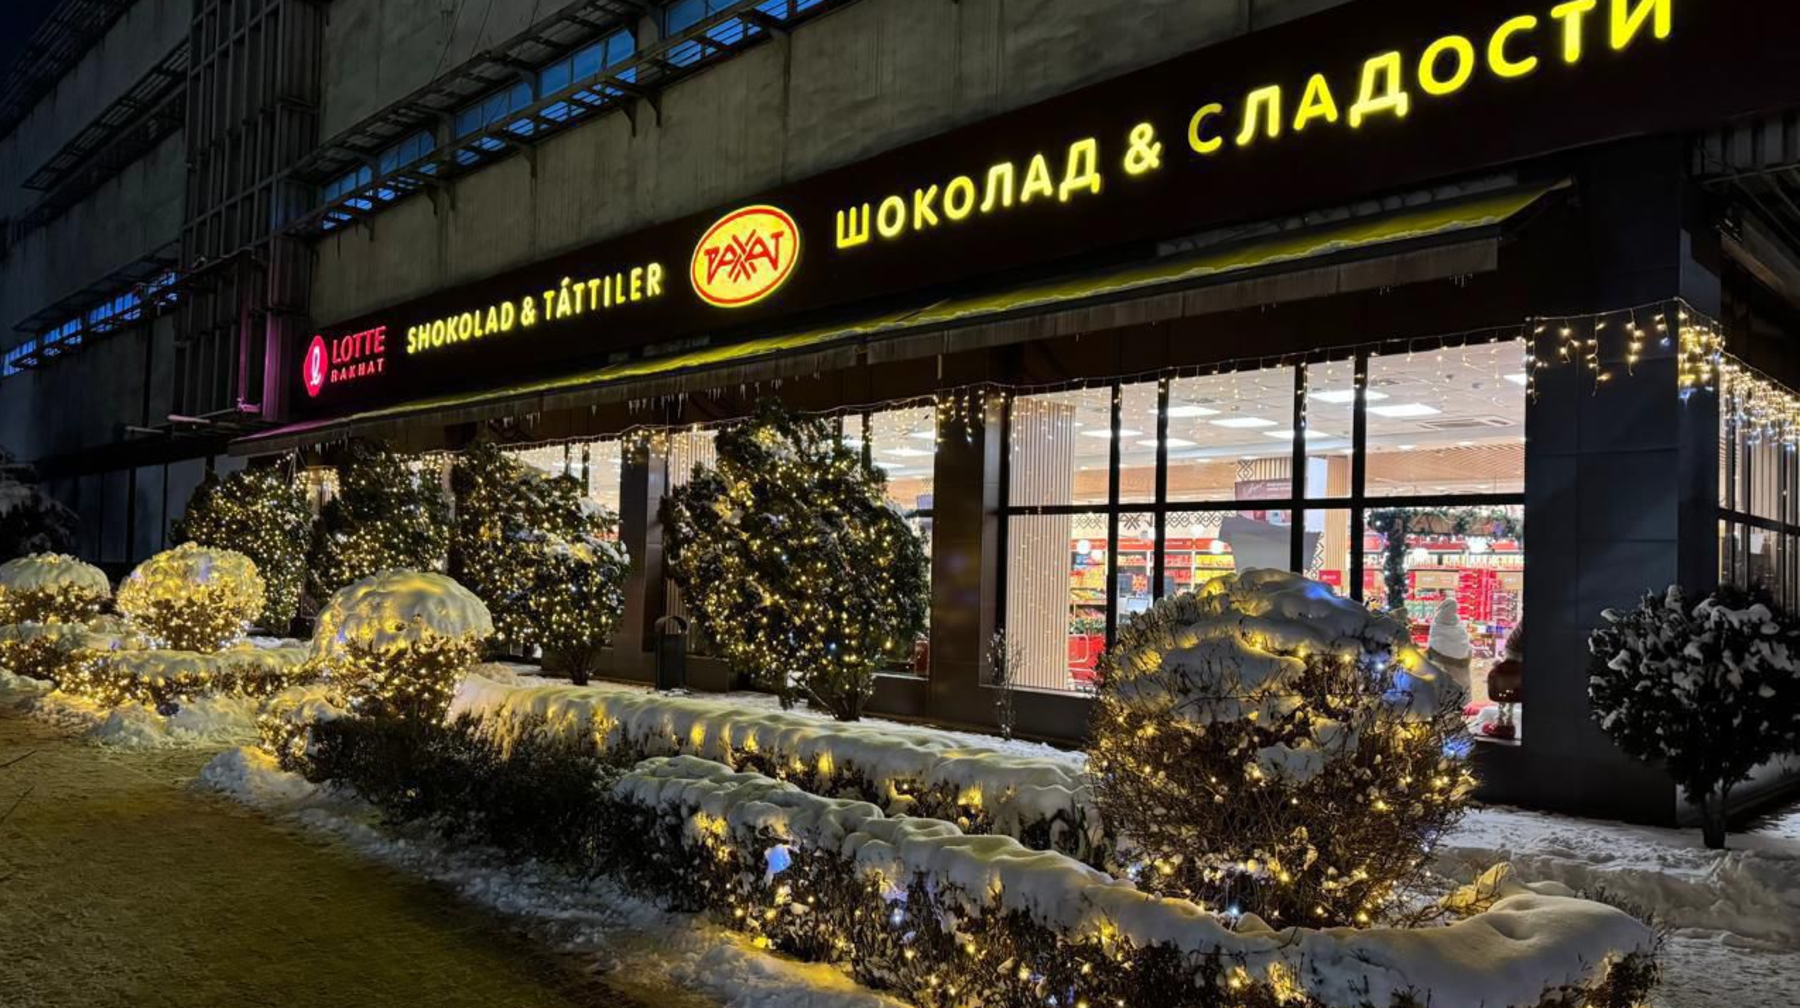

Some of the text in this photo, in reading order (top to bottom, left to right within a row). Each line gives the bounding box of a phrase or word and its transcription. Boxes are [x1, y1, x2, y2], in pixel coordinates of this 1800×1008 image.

[836, 0, 1672, 249] ШОКОЛАД & СЛАДОСТИ
[407, 262, 663, 354] SHOKOLAD & TÁTTILER
[330, 358, 385, 383] RAKHAT
[332, 325, 386, 364] LOTTE
